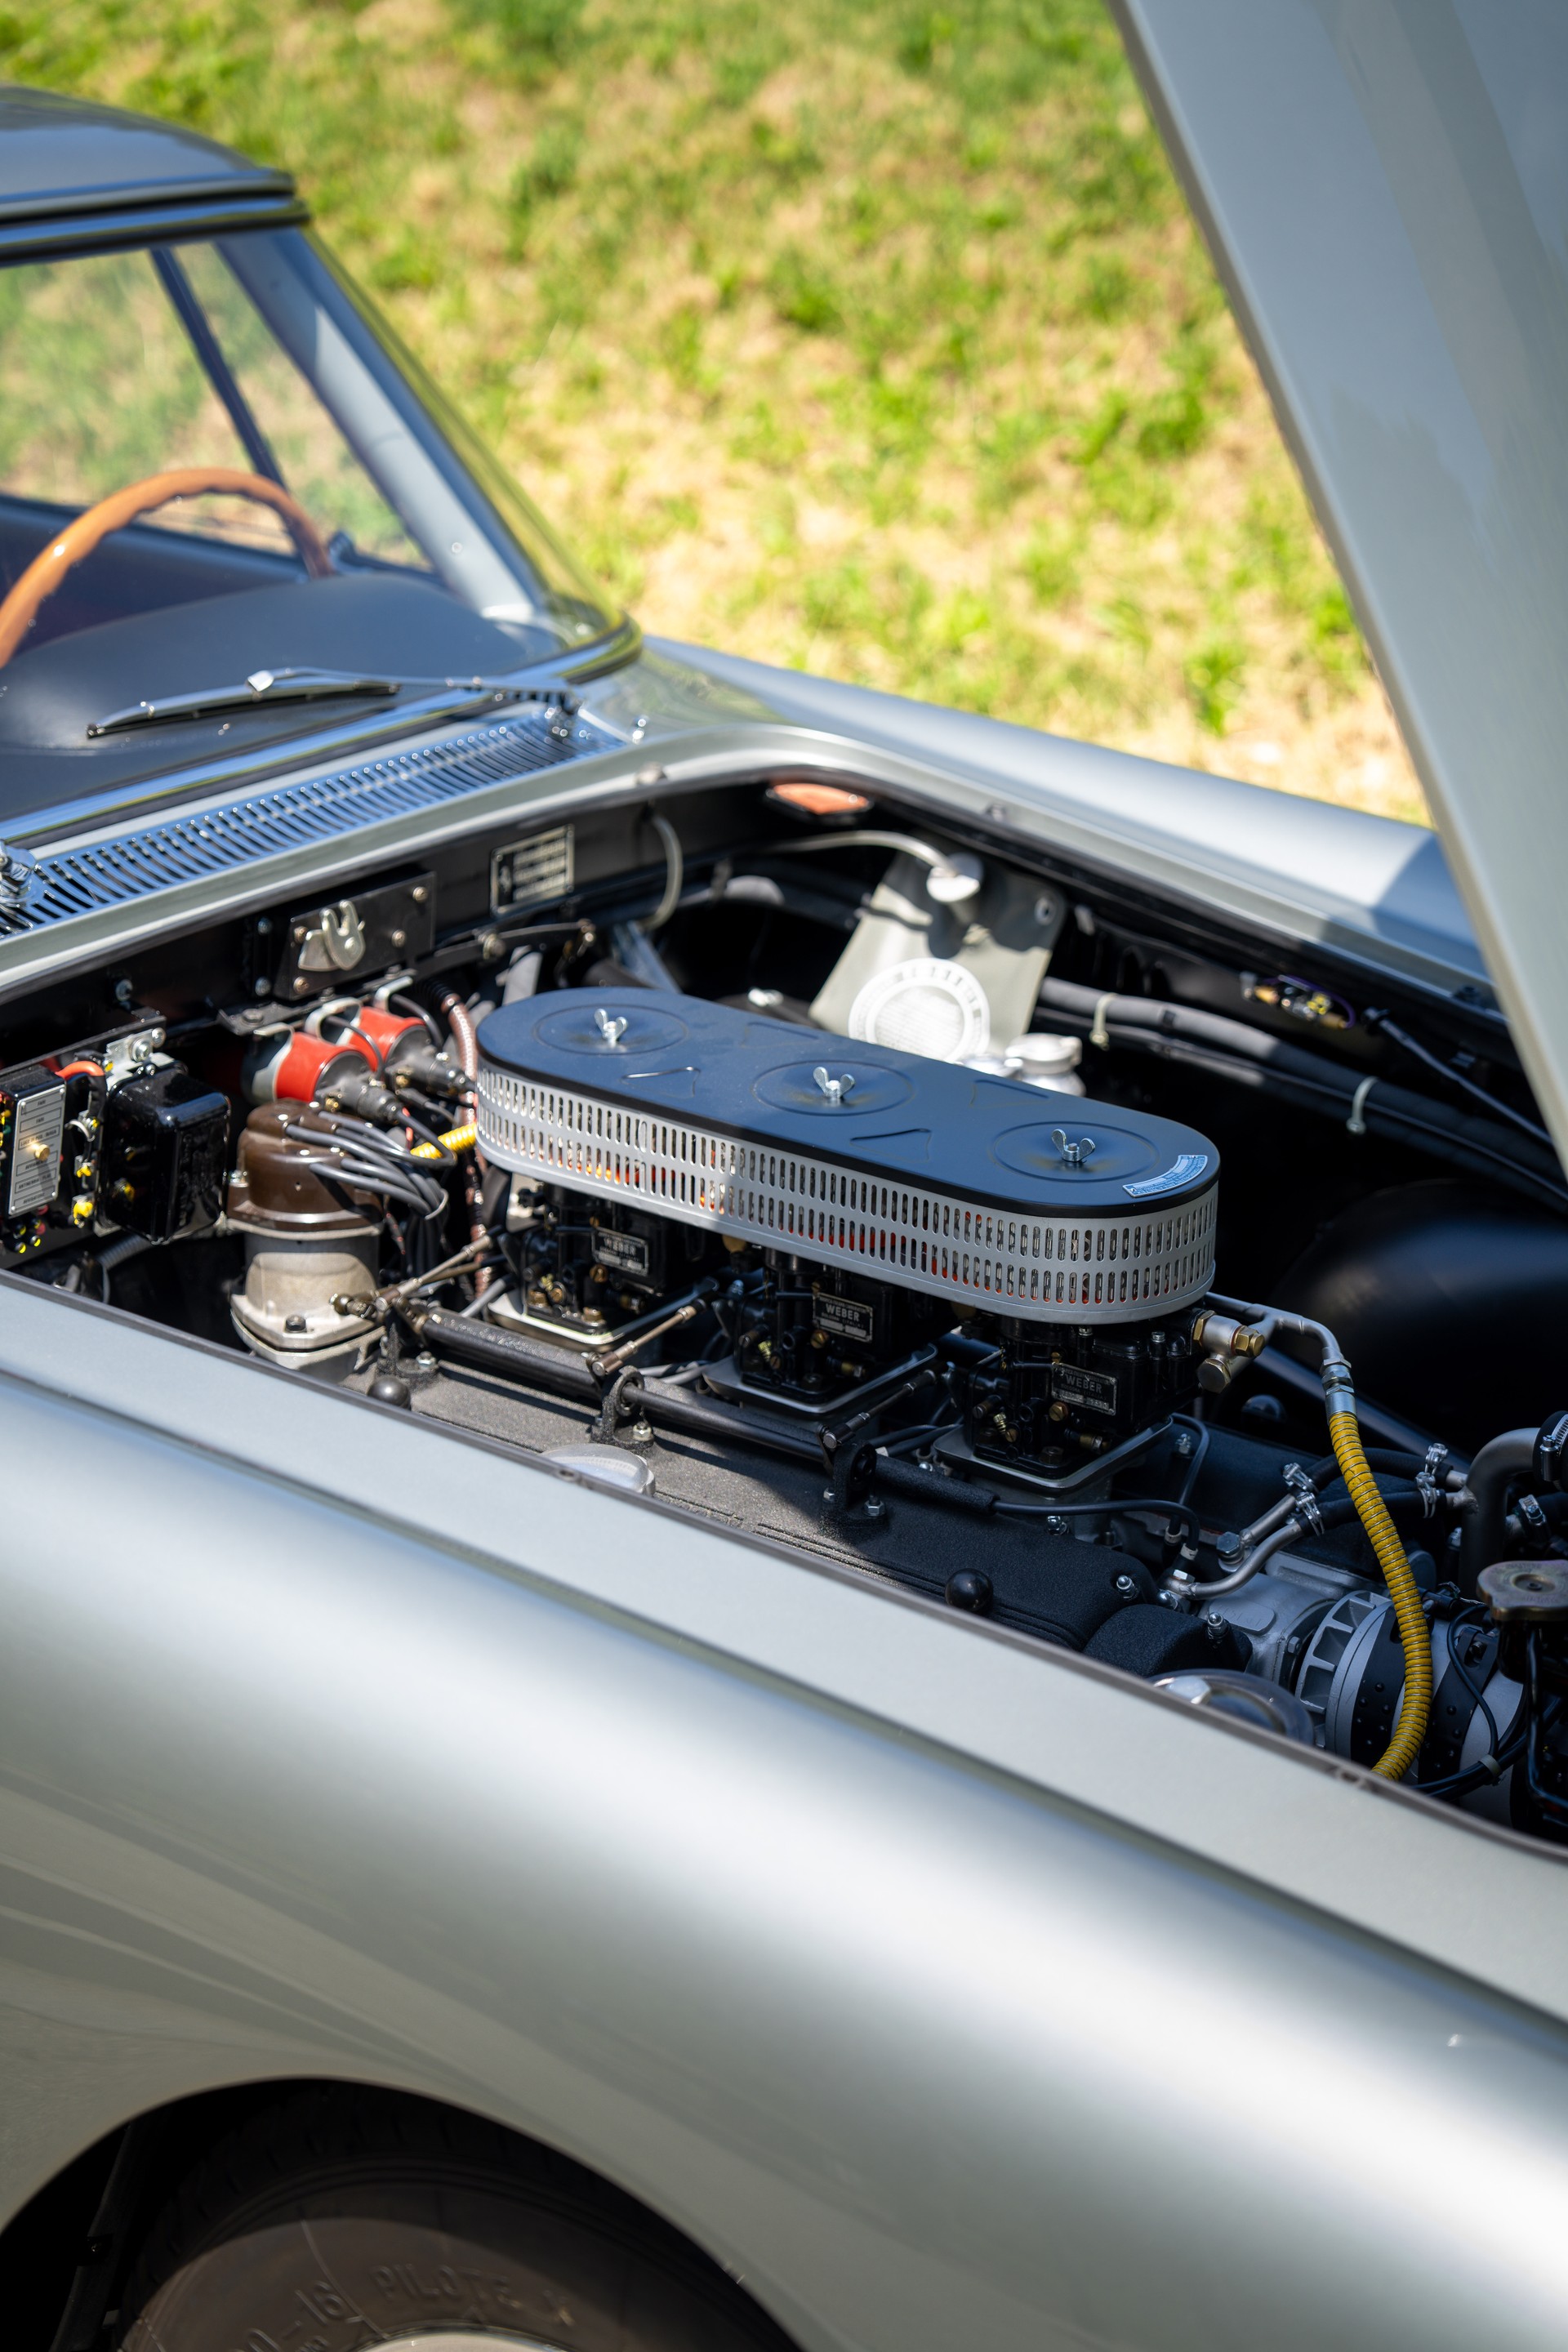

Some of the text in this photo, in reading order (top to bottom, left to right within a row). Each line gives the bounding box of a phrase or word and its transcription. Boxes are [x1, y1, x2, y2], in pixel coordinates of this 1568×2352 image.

[604, 1236, 637, 1256] WEBER
[825, 1303, 860, 1322] WEBER
[1064, 1373, 1103, 1394] WEBER
[368, 2263, 523, 2309] PILOTE
